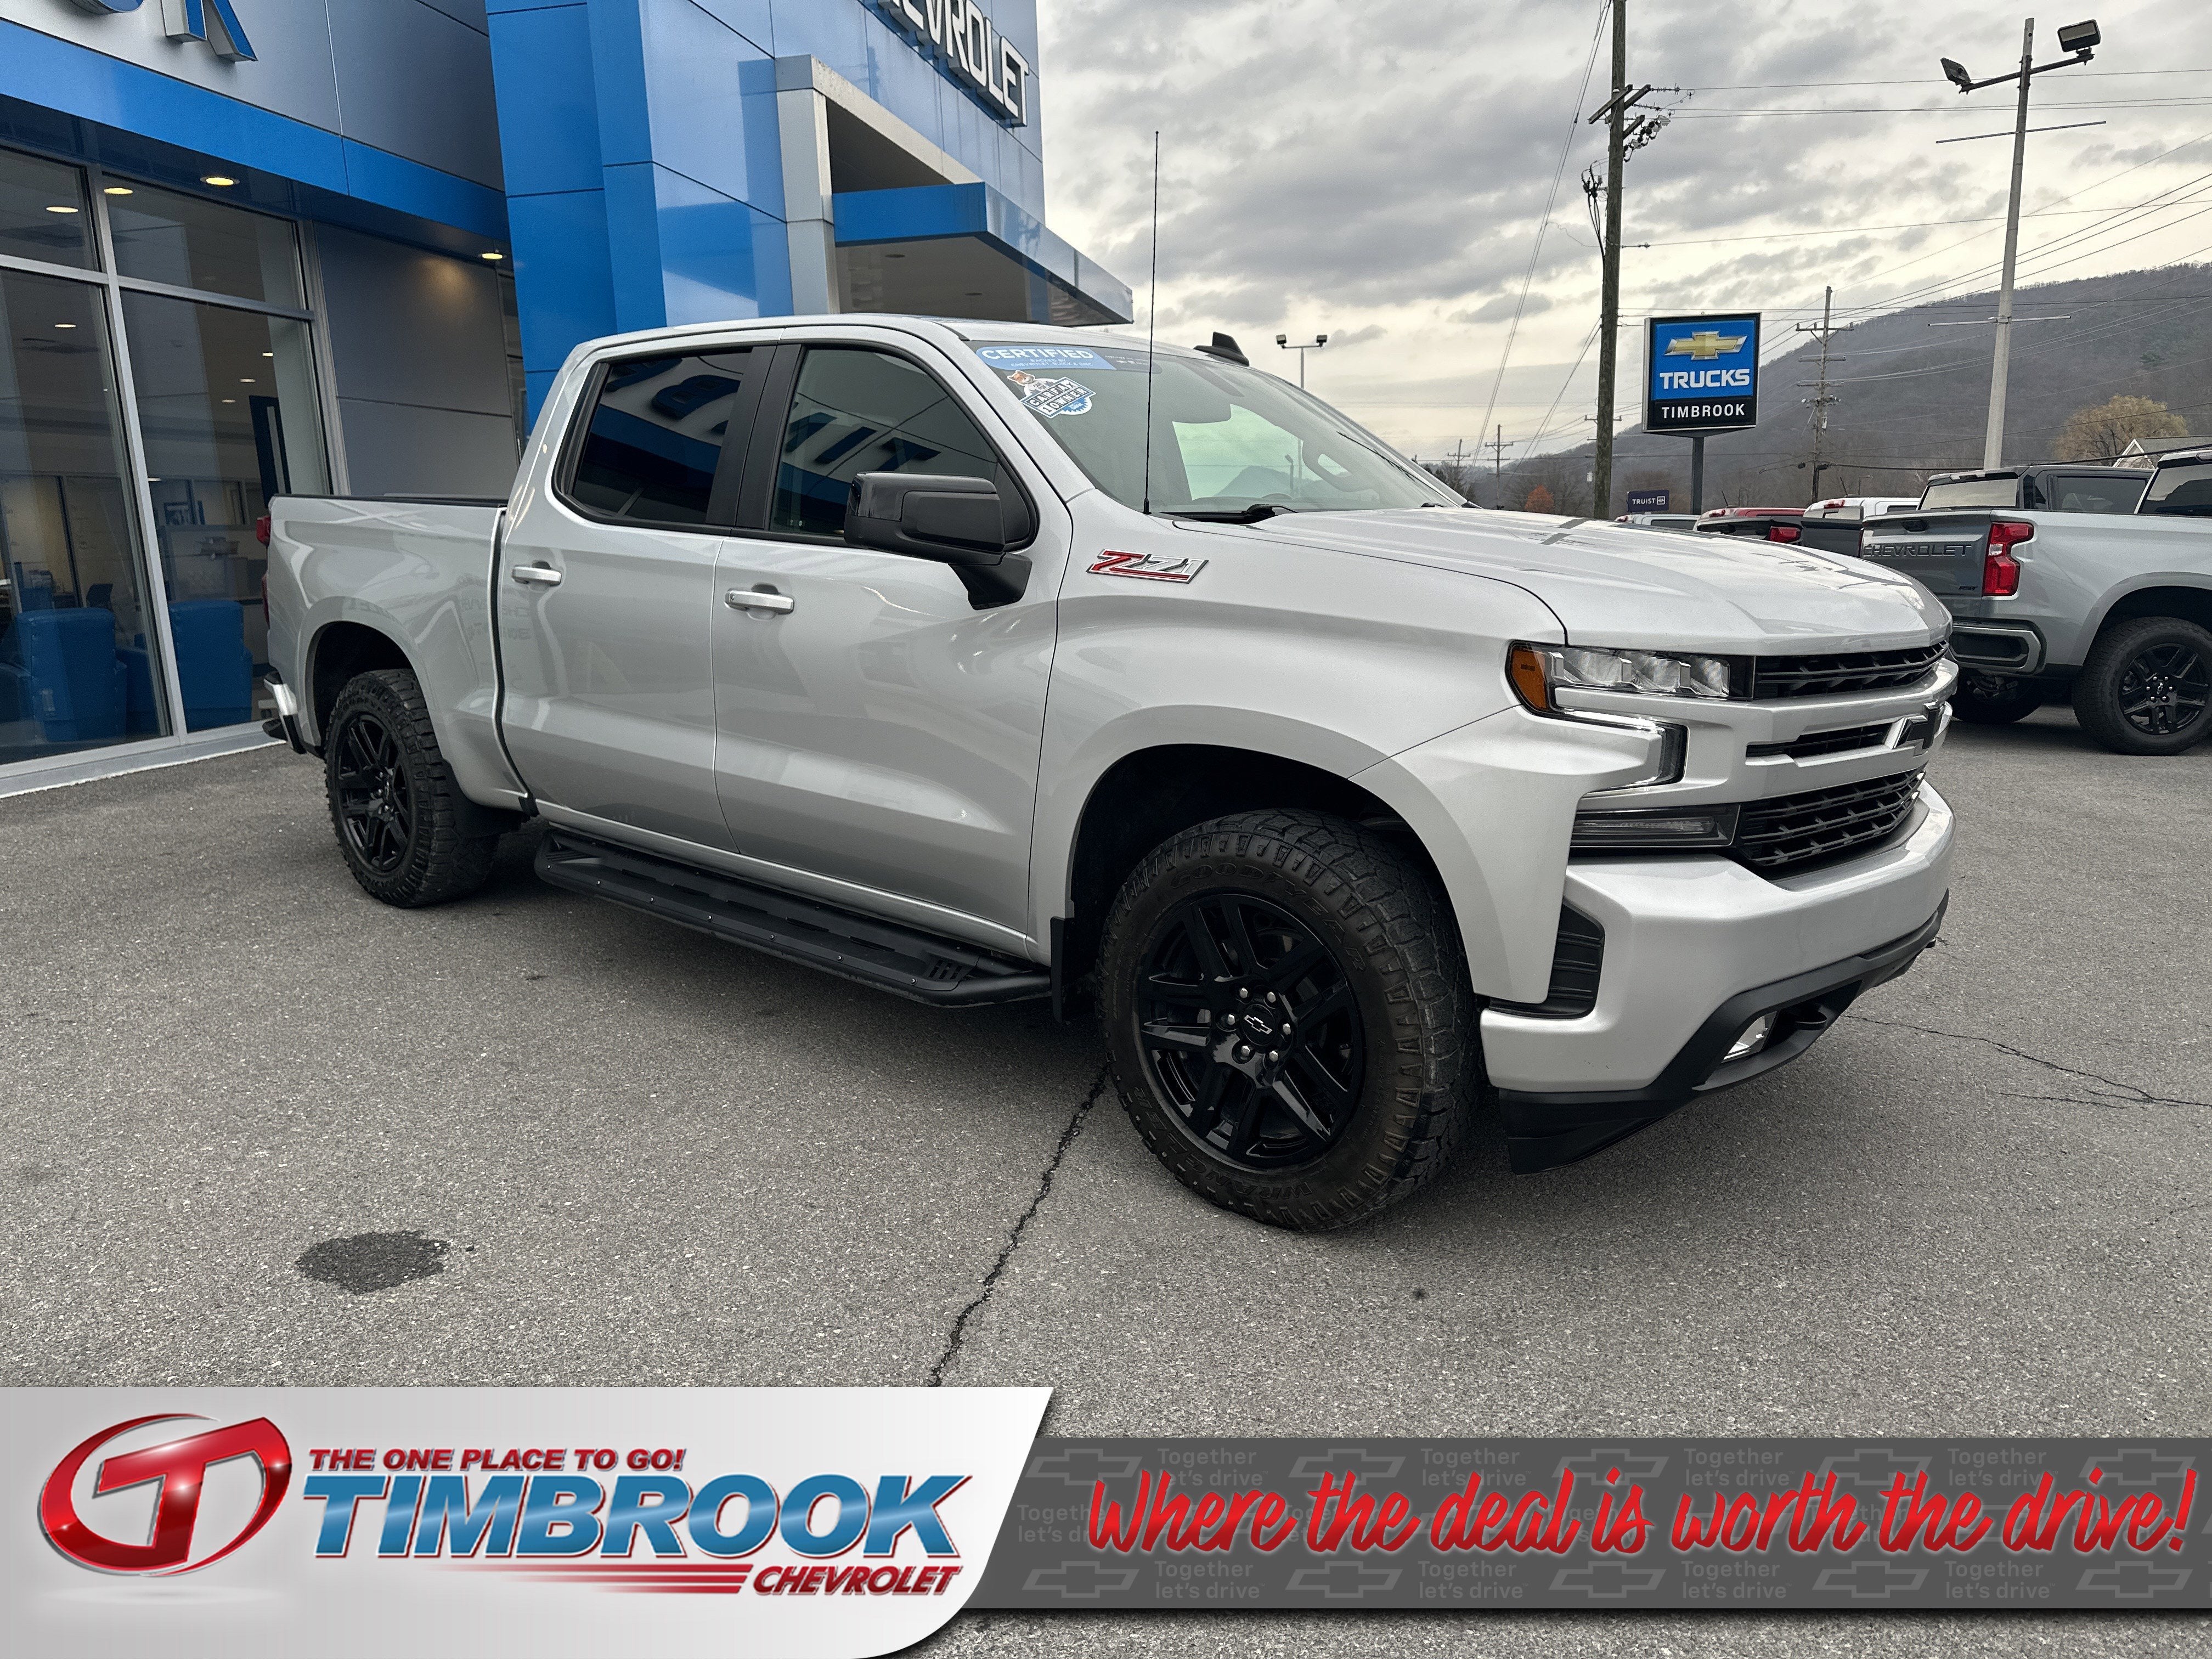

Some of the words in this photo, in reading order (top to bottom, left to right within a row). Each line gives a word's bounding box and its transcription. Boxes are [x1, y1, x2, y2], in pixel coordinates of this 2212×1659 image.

[981, 348, 1094, 359] CERTIFIED
[1660, 369, 1750, 390] TRUCKS
[1029, 382, 1076, 407] CARFAX
[1661, 403, 1746, 419] TIMBROOK
[1863, 544, 1972, 557] CHEVROLET
[1086, 549, 1209, 584] Z71
[1170, 862, 1367, 972] GOODYEAR
